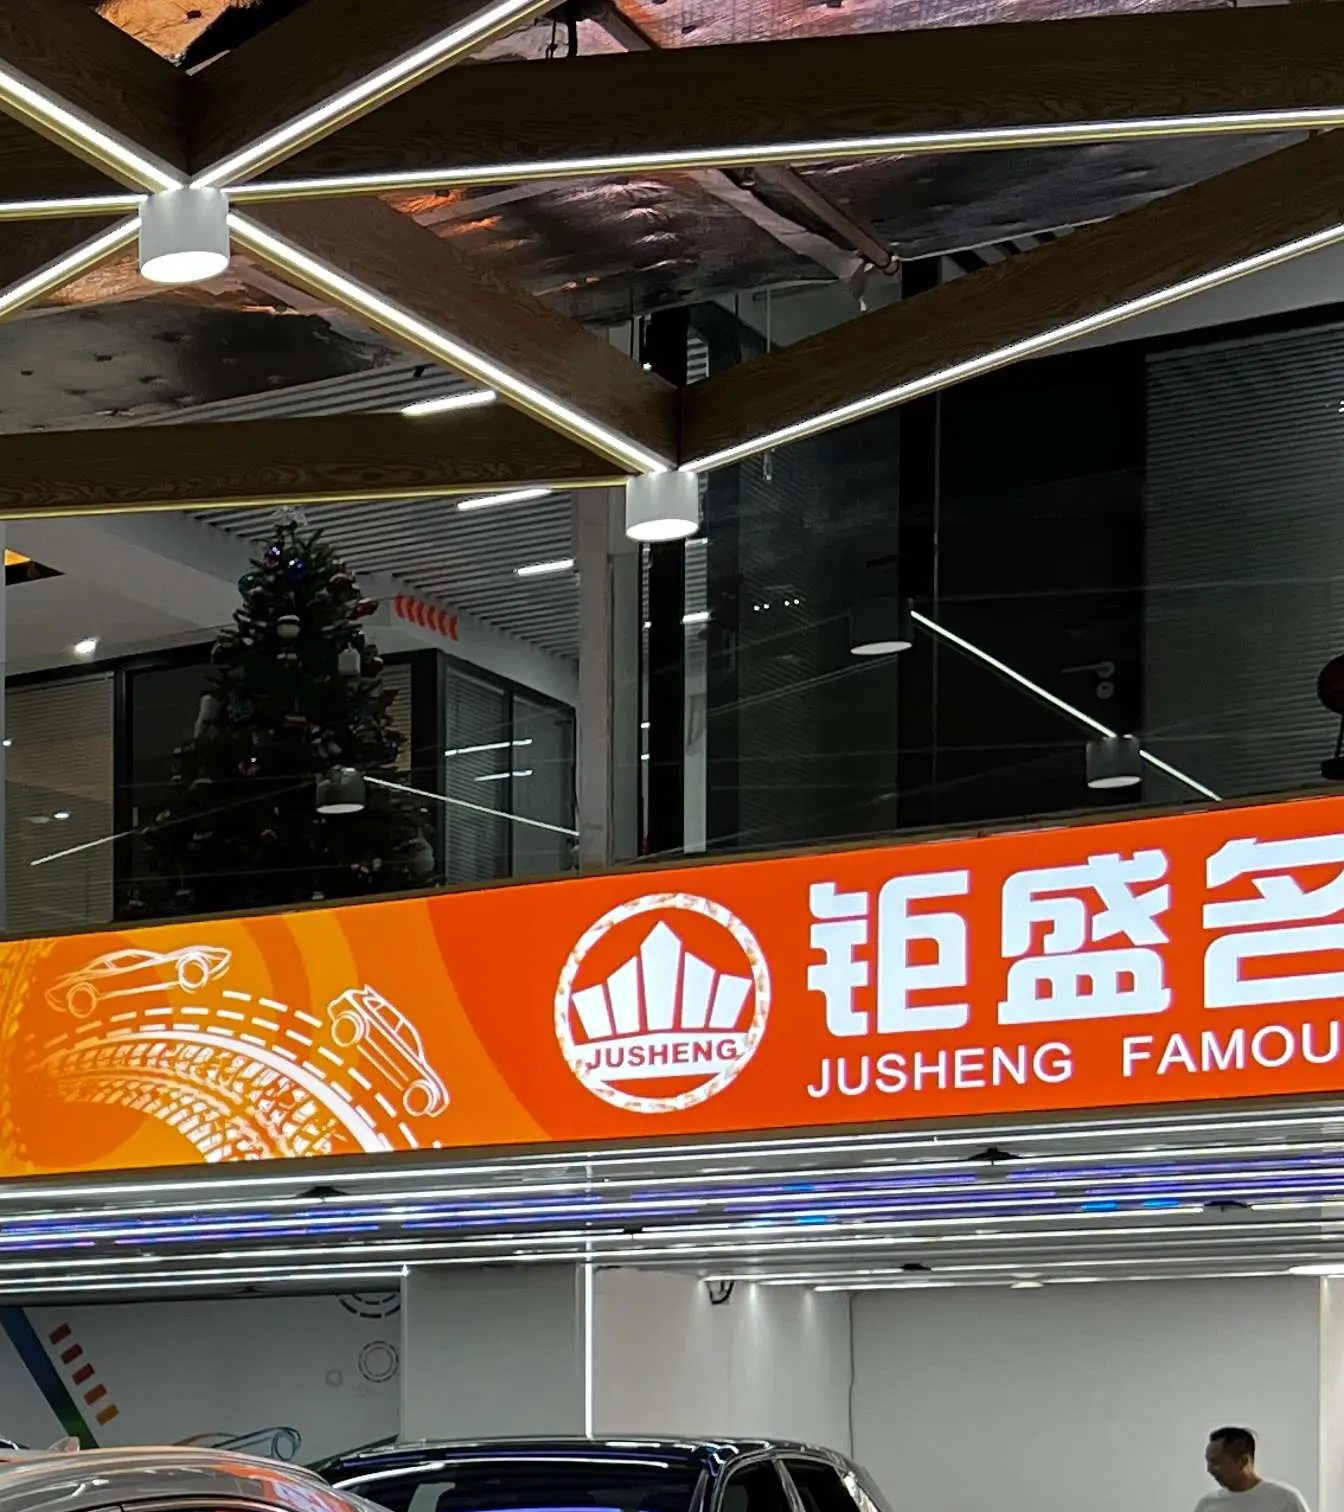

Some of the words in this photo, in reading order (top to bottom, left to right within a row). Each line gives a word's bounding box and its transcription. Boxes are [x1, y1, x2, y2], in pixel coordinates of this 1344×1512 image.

[807, 833, 1344, 1037] 钜盛名
[585, 1038, 737, 1070] JUSHENG
[807, 1042, 1073, 1098] JUSHENG
